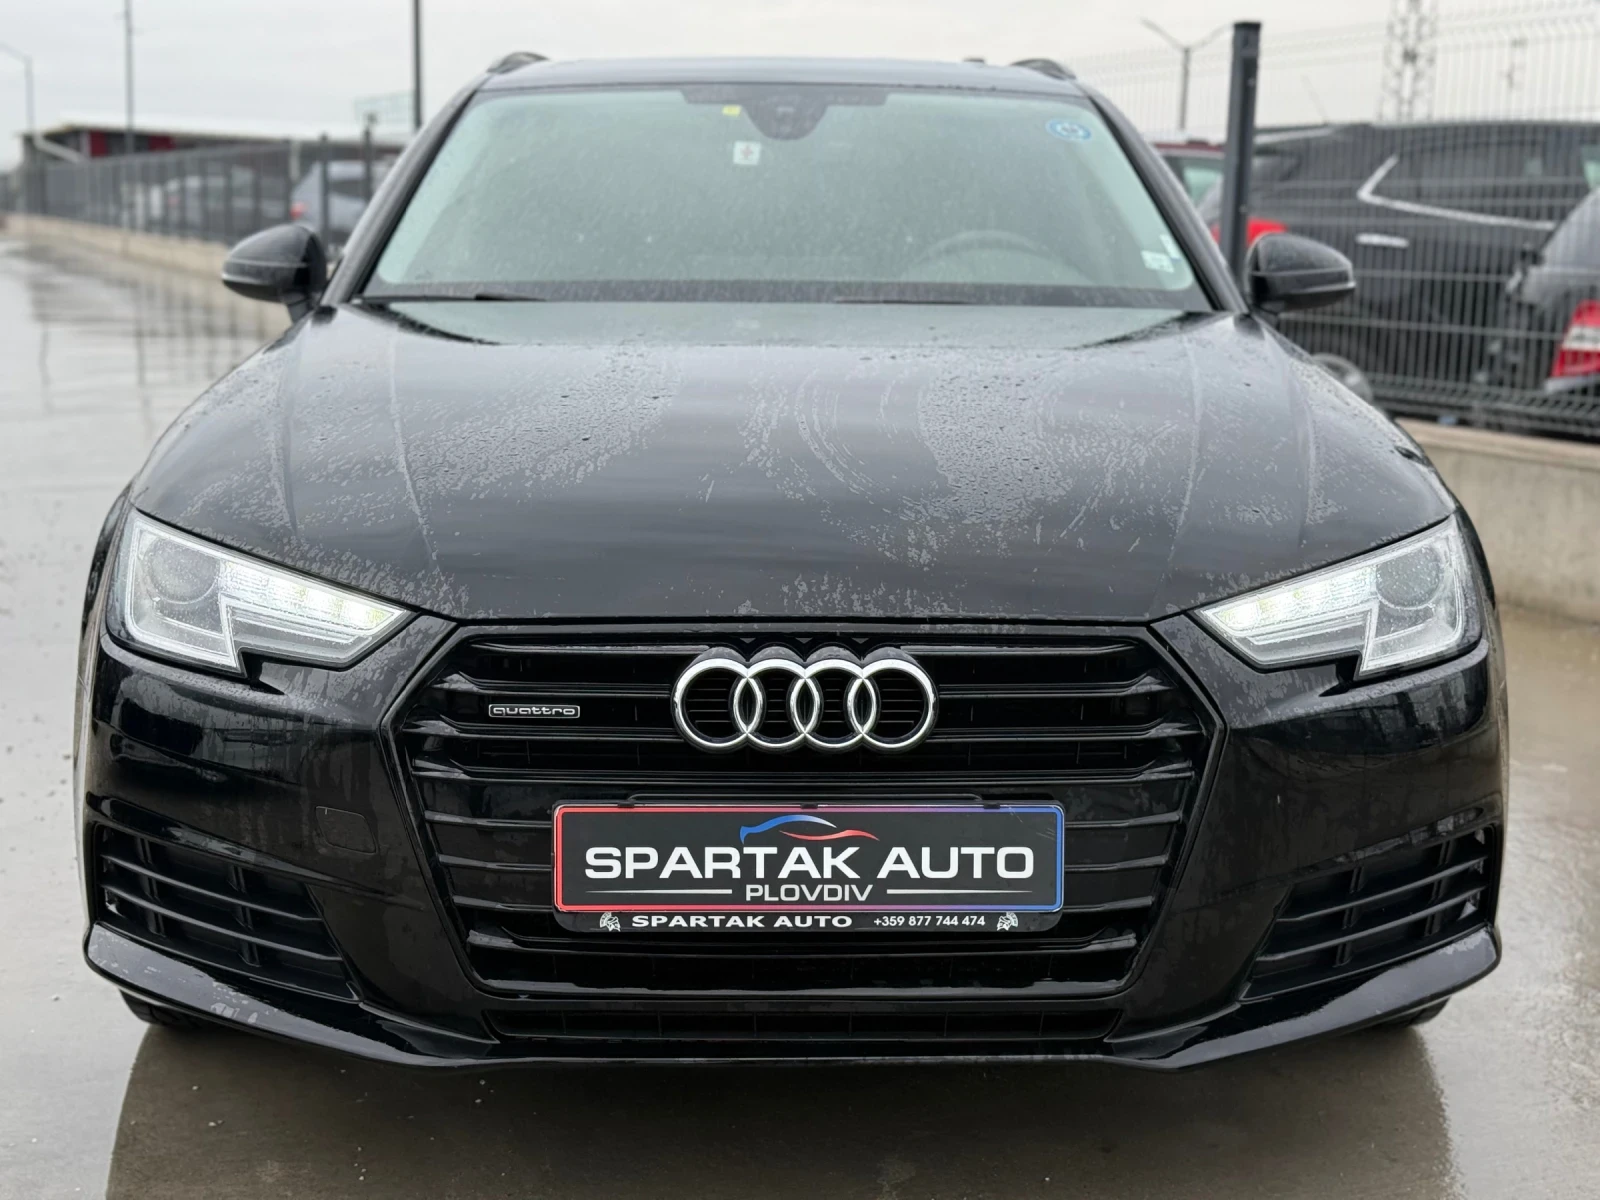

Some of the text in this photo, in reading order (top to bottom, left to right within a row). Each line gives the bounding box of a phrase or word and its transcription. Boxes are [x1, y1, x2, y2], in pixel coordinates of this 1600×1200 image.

[493, 707, 575, 716] quattro
[585, 846, 1035, 879] SPARTAK AUTO
[745, 883, 874, 902] PLOVDIV
[631, 915, 986, 928] SPARTAK AUTO +359 877 744 474
